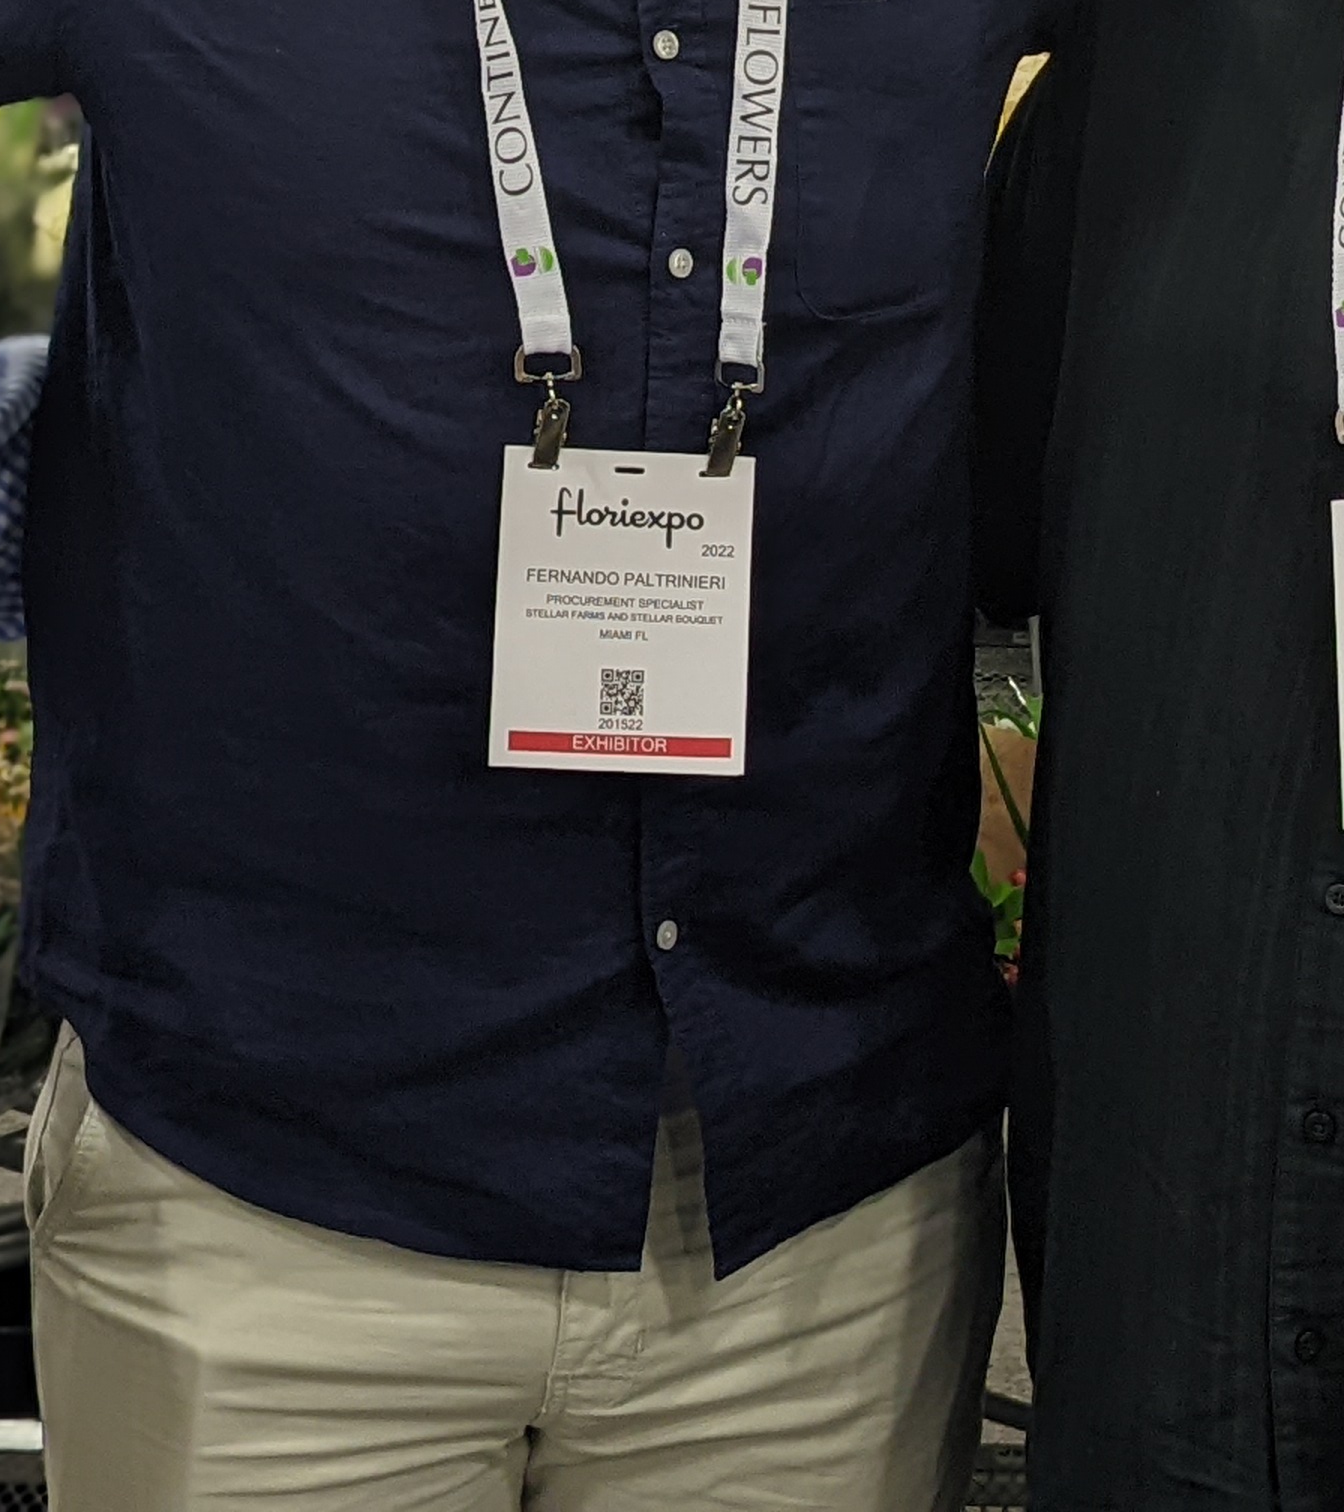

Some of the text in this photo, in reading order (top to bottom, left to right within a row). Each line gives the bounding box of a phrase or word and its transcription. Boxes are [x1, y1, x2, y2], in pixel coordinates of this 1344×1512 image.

[731, 3, 782, 206] FLOWERS
[551, 487, 705, 549] floriexpo
[701, 544, 735, 558] 2022
[525, 568, 726, 590] FERNANDO PALTRINIERI
[546, 594, 704, 611] PROCUREMENT SPECIALIST
[525, 608, 723, 626] STELLAR FARMS AND STELLAR BOUQUET
[599, 629, 649, 641] MIAMI FL
[598, 718, 643, 731] 201522
[572, 735, 668, 753] EXHIBITOR
